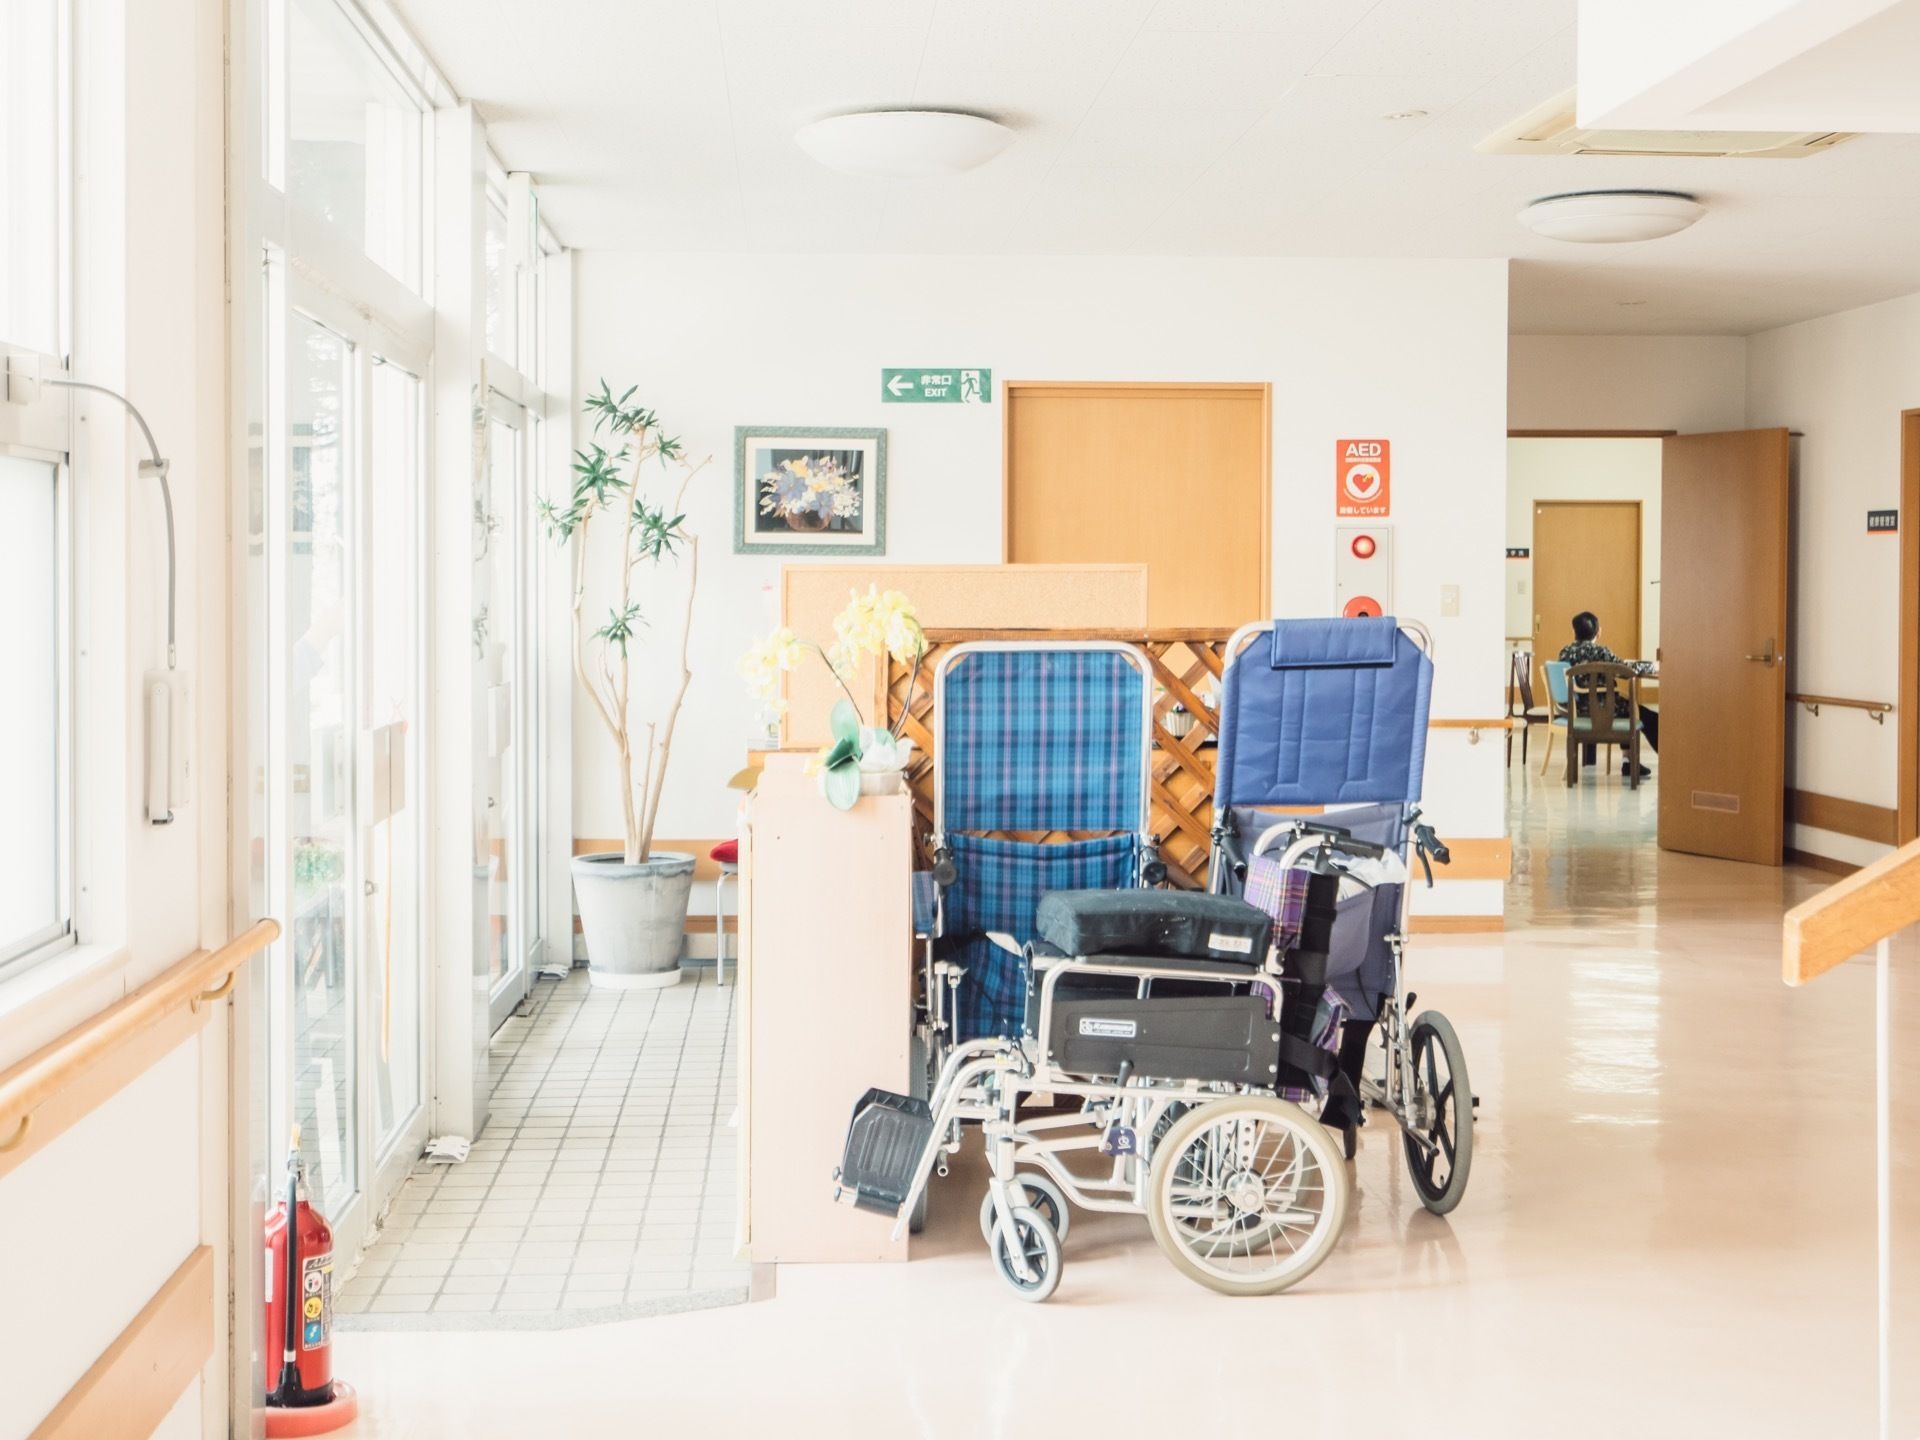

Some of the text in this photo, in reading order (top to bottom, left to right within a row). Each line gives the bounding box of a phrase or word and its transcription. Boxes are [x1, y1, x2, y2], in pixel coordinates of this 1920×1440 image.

[921, 375, 952, 386] 非常口
[924, 387, 948, 397] EXIT
[1345, 443, 1381, 457] AED
